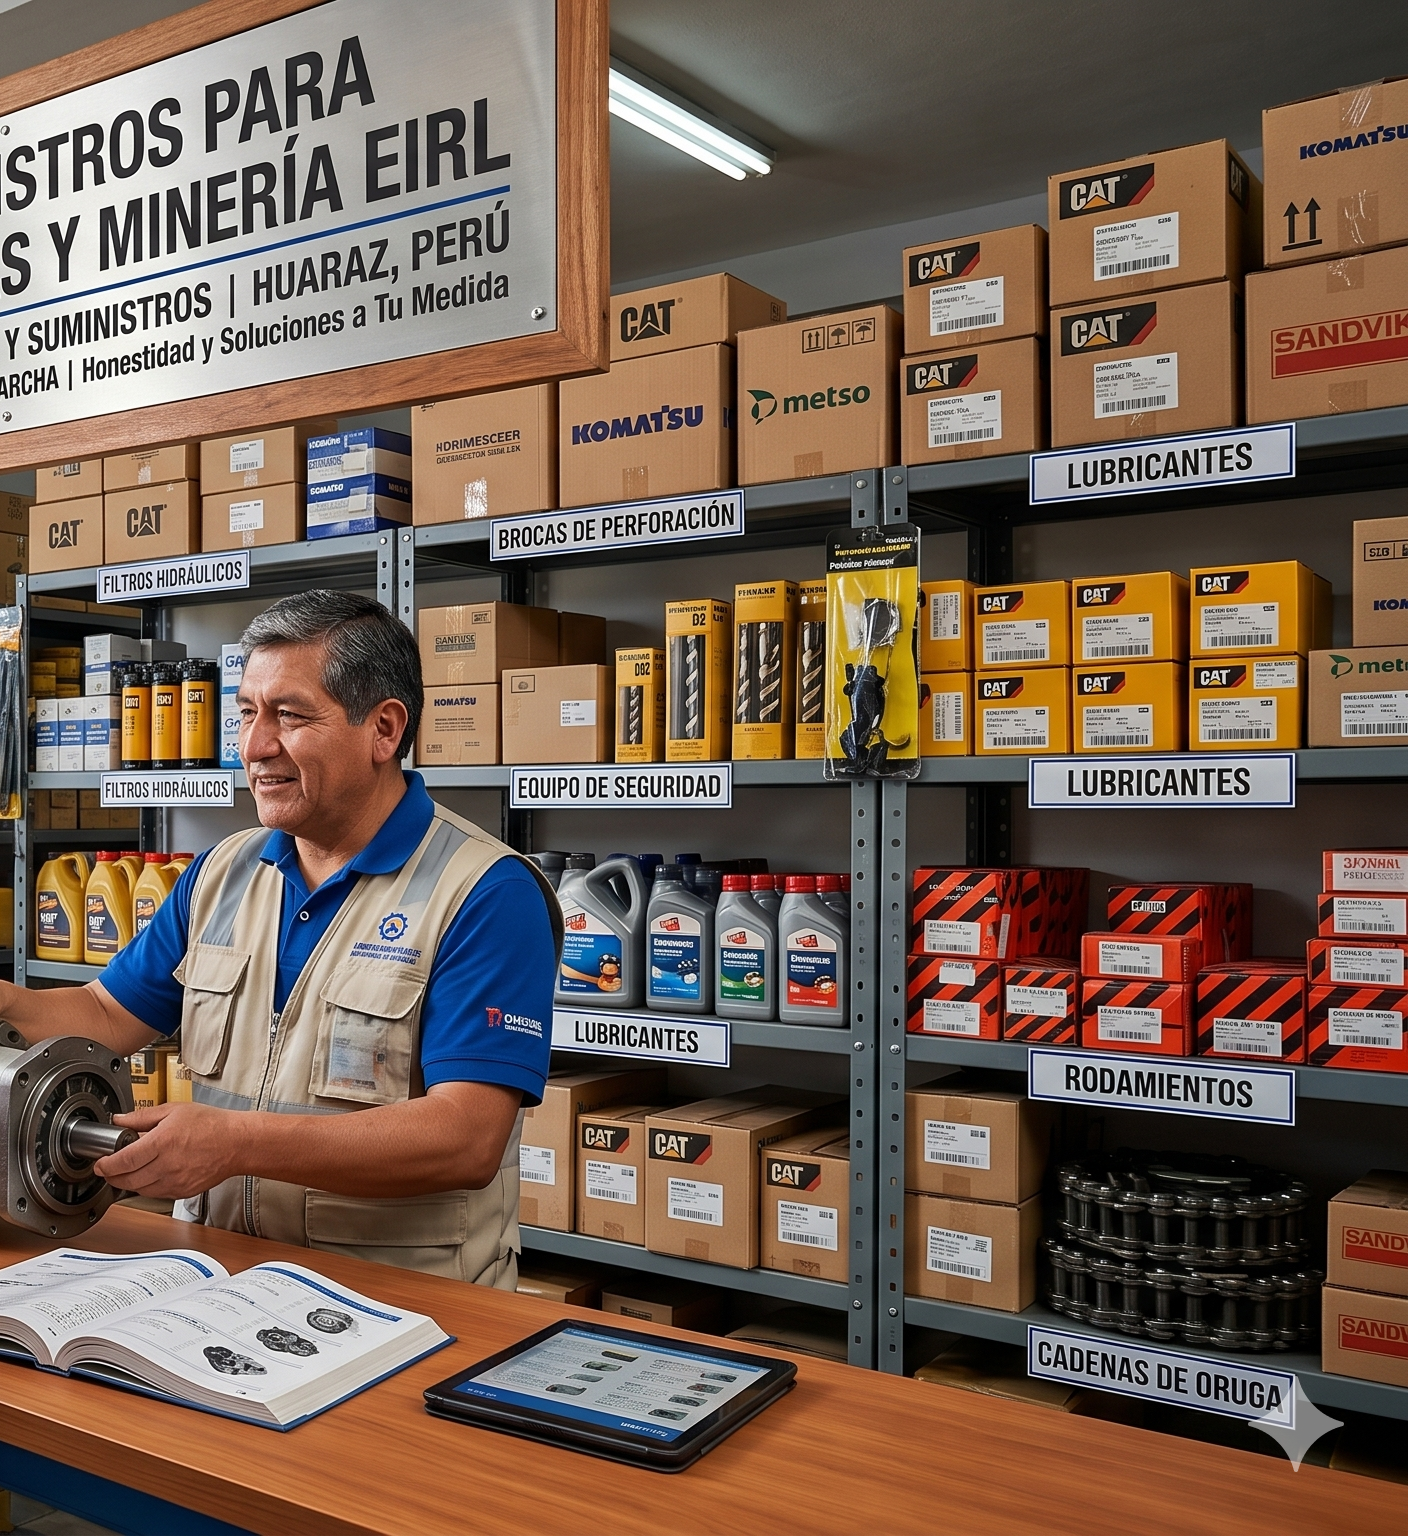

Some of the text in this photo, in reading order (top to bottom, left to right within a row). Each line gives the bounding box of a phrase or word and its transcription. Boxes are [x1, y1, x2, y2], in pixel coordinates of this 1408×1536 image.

[204, 35, 376, 153] PARA
[1300, 124, 1408, 160] KOMATSU
[47, 215, 81, 283] Y
[99, 133, 344, 272] MINERÍA
[365, 97, 512, 204] EIRL
[1070, 175, 1121, 212] CAT
[4, 327, 21, 361] Y
[27, 282, 212, 356] SUMINISTROS
[253, 238, 399, 306] HUARAZ,
[411, 200, 510, 271] PERÚ
[917, 252, 956, 281] CAT
[82, 335, 195, 383] Honestidad
[201, 336, 215, 364] y
[220, 309, 344, 355] Soluciones
[352, 304, 367, 328] a
[374, 293, 403, 323] Tu
[412, 270, 510, 316] Medida
[620, 298, 675, 343] CAT
[1071, 313, 1123, 348] CAT
[1274, 313, 1408, 353] SANDVIK
[914, 362, 953, 390] CAT
[783, 385, 871, 415] metso
[572, 405, 704, 446] KOMATSU
[1067, 442, 1253, 489] LUBRICANTES
[48, 519, 80, 549] CAT
[127, 504, 164, 538] CAT
[498, 500, 735, 550] BROCAS DE PERFORACIÓN
[104, 560, 242, 594] FILTROS HIDRÁULICOS
[1201, 576, 1230, 593] CAT
[983, 595, 1010, 611] CAT
[1083, 587, 1110, 603] CAT
[1200, 668, 1231, 686] CAT
[1359, 659, 1408, 673] met
[983, 681, 1010, 697] CAT
[1083, 676, 1111, 692] CAT
[434, 697, 477, 707] KOMATSU
[105, 777, 229, 799] FILTROS HIDRÁULICOS
[517, 774, 722, 799] EQUIPO DE SEGURIDAD
[1067, 767, 1251, 797] LUBRICANTES
[575, 1020, 699, 1054] LUBRICANTES
[1065, 1064, 1253, 1108] RODAMIENTOS
[585, 1126, 613, 1149] CAT
[654, 1133, 688, 1159] CAT
[771, 1162, 804, 1186] CAT
[1345, 1229, 1408, 1251] SAND
[1038, 1340, 1284, 1414] CADENAS DE ORUGA
